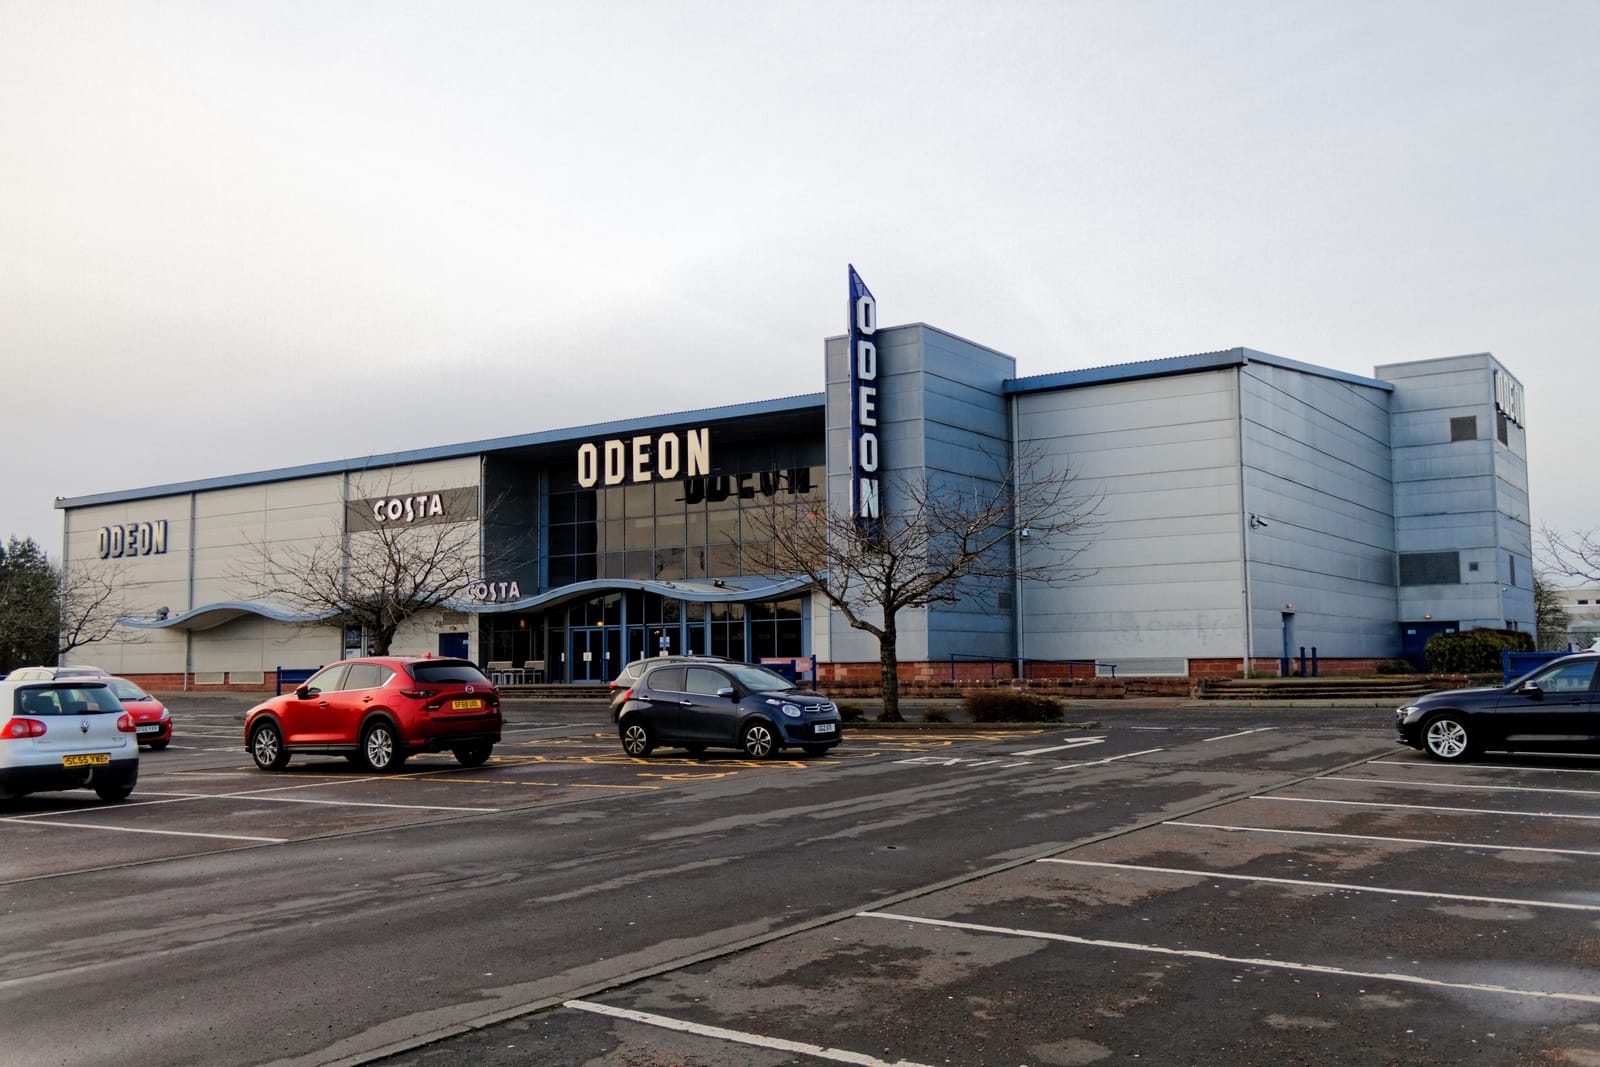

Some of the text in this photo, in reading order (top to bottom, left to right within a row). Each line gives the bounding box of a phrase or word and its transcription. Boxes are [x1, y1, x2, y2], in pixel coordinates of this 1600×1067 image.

[857, 296, 878, 518] ODEON
[578, 427, 710, 488] ODEON
[373, 494, 444, 522] COSTA
[97, 519, 168, 559] ODEON
[468, 581, 520, 601] COSTA
[66, 755, 89, 766] SC55
